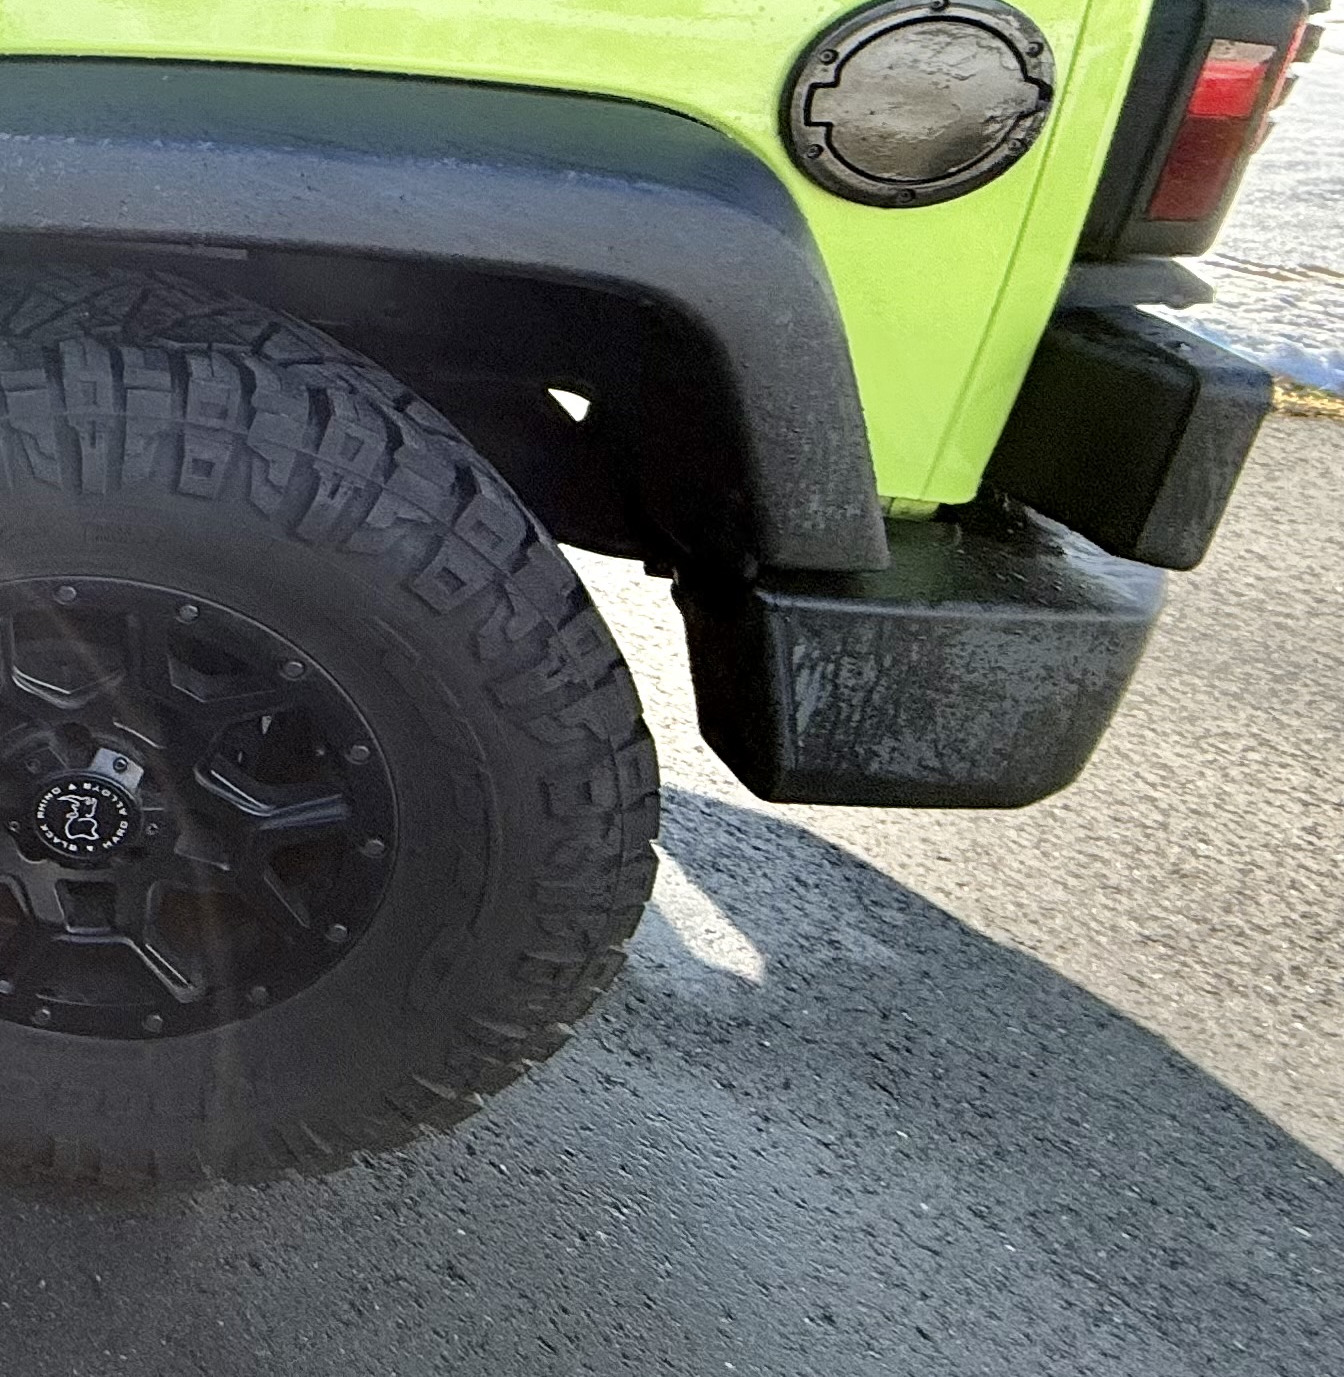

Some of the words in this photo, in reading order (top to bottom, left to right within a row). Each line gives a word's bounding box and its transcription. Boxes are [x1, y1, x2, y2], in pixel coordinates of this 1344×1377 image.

[37, 787, 61, 819] RHINO
[83, 783, 128, 816] ALLOYS
[40, 824, 78, 851] BLACK
[102, 821, 128, 849] HARD
